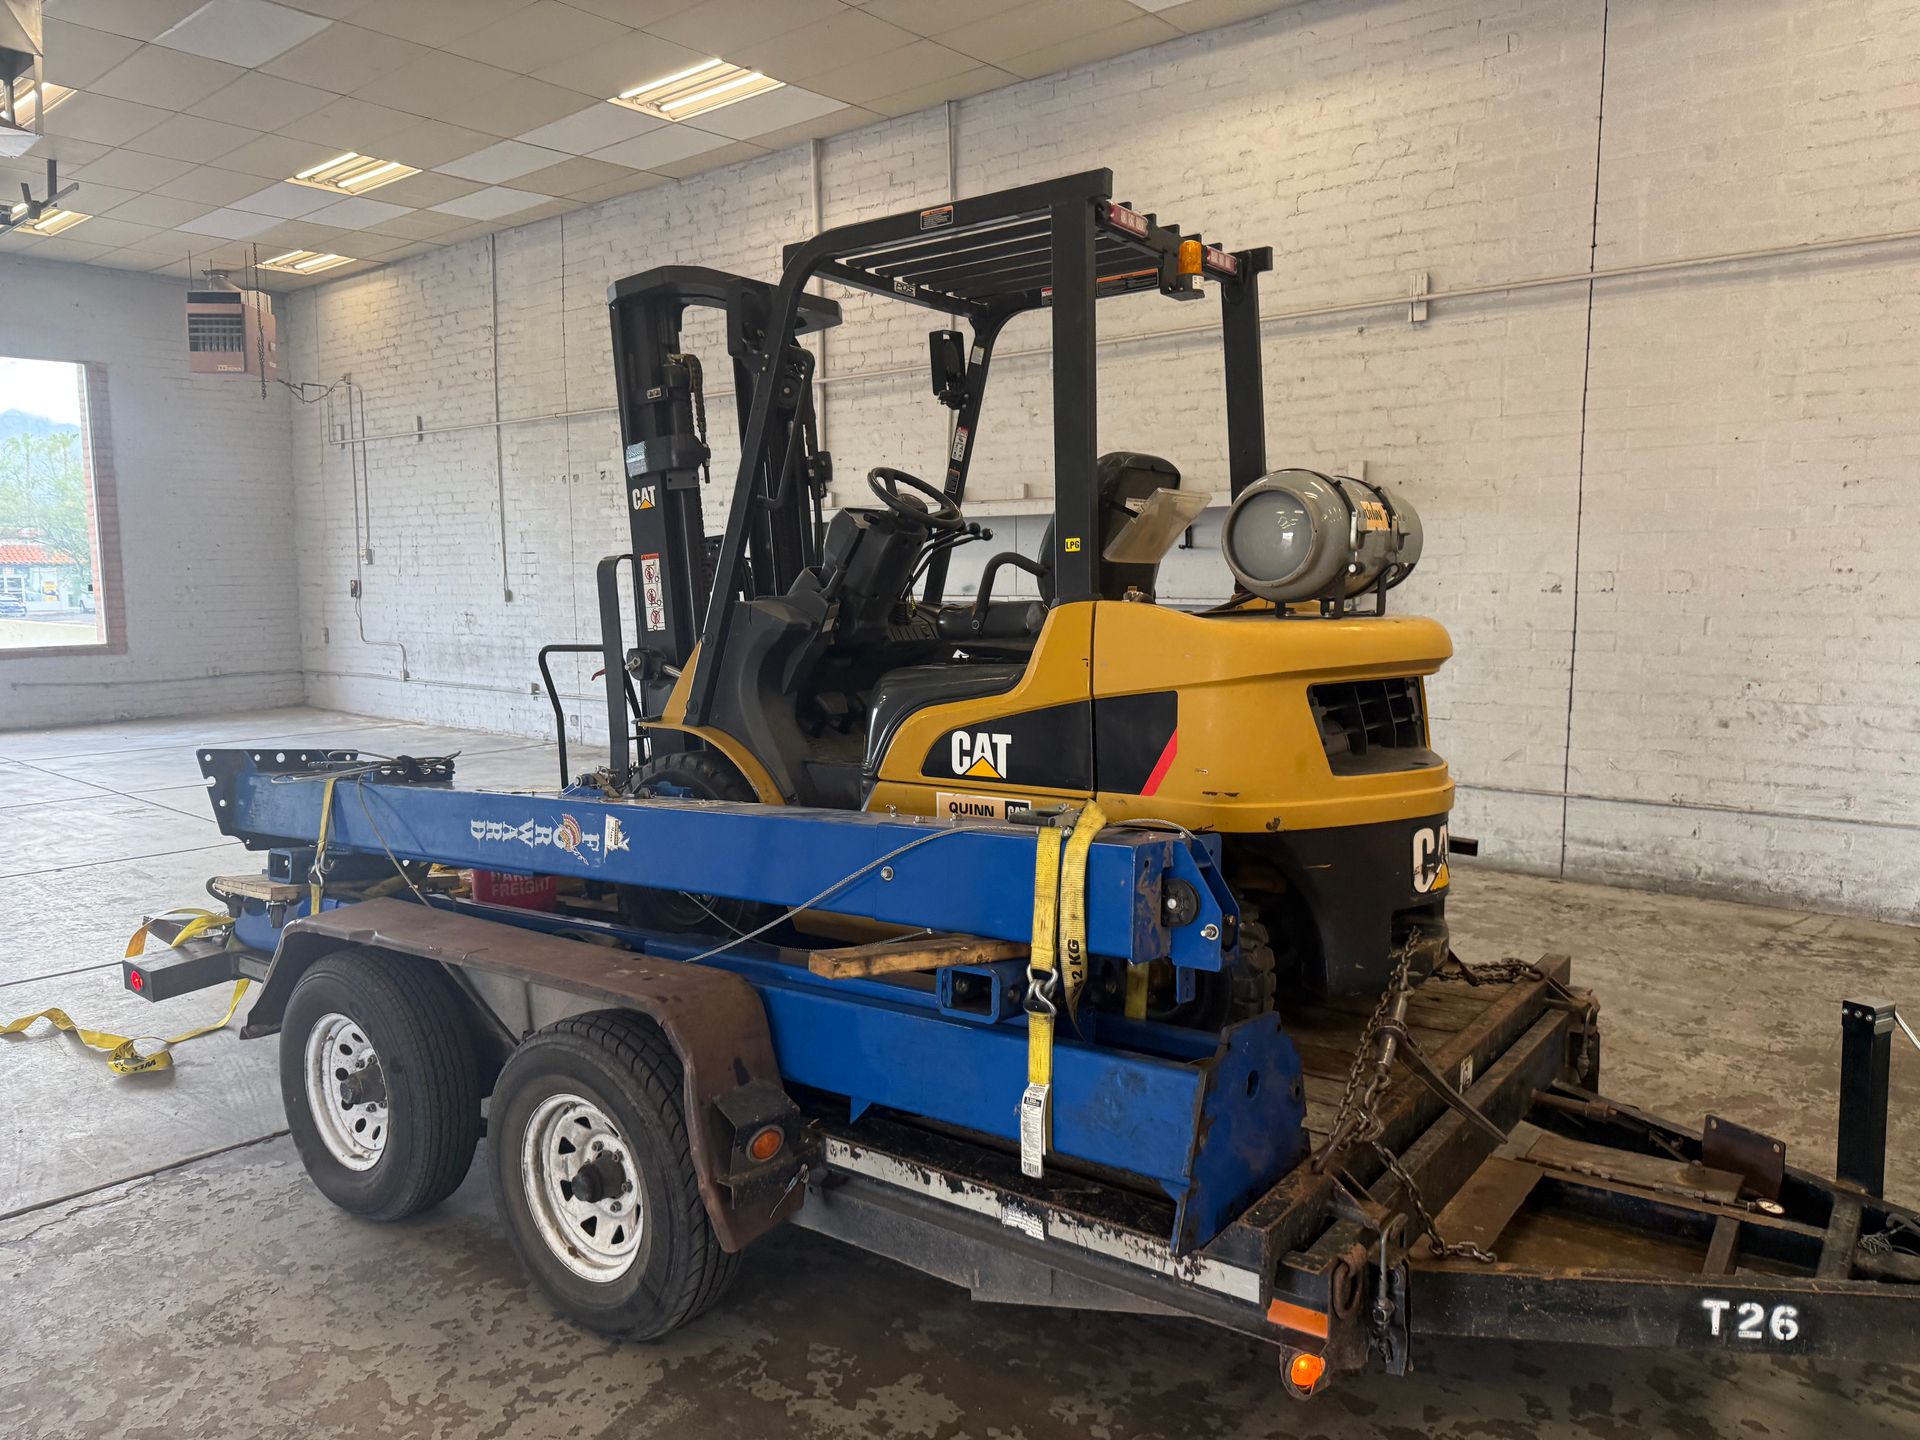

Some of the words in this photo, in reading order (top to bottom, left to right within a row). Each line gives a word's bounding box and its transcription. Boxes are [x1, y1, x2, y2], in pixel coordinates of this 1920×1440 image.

[632, 486, 656, 510] CAT
[1066, 540, 1080, 549] LPG
[951, 730, 1012, 779] CAT
[949, 802, 994, 817] QUINN
[1413, 824, 1449, 893] CA
[491, 876, 551, 897] FREIGHT
[1068, 939, 1081, 965] KG
[1702, 1299, 1799, 1340] T26
